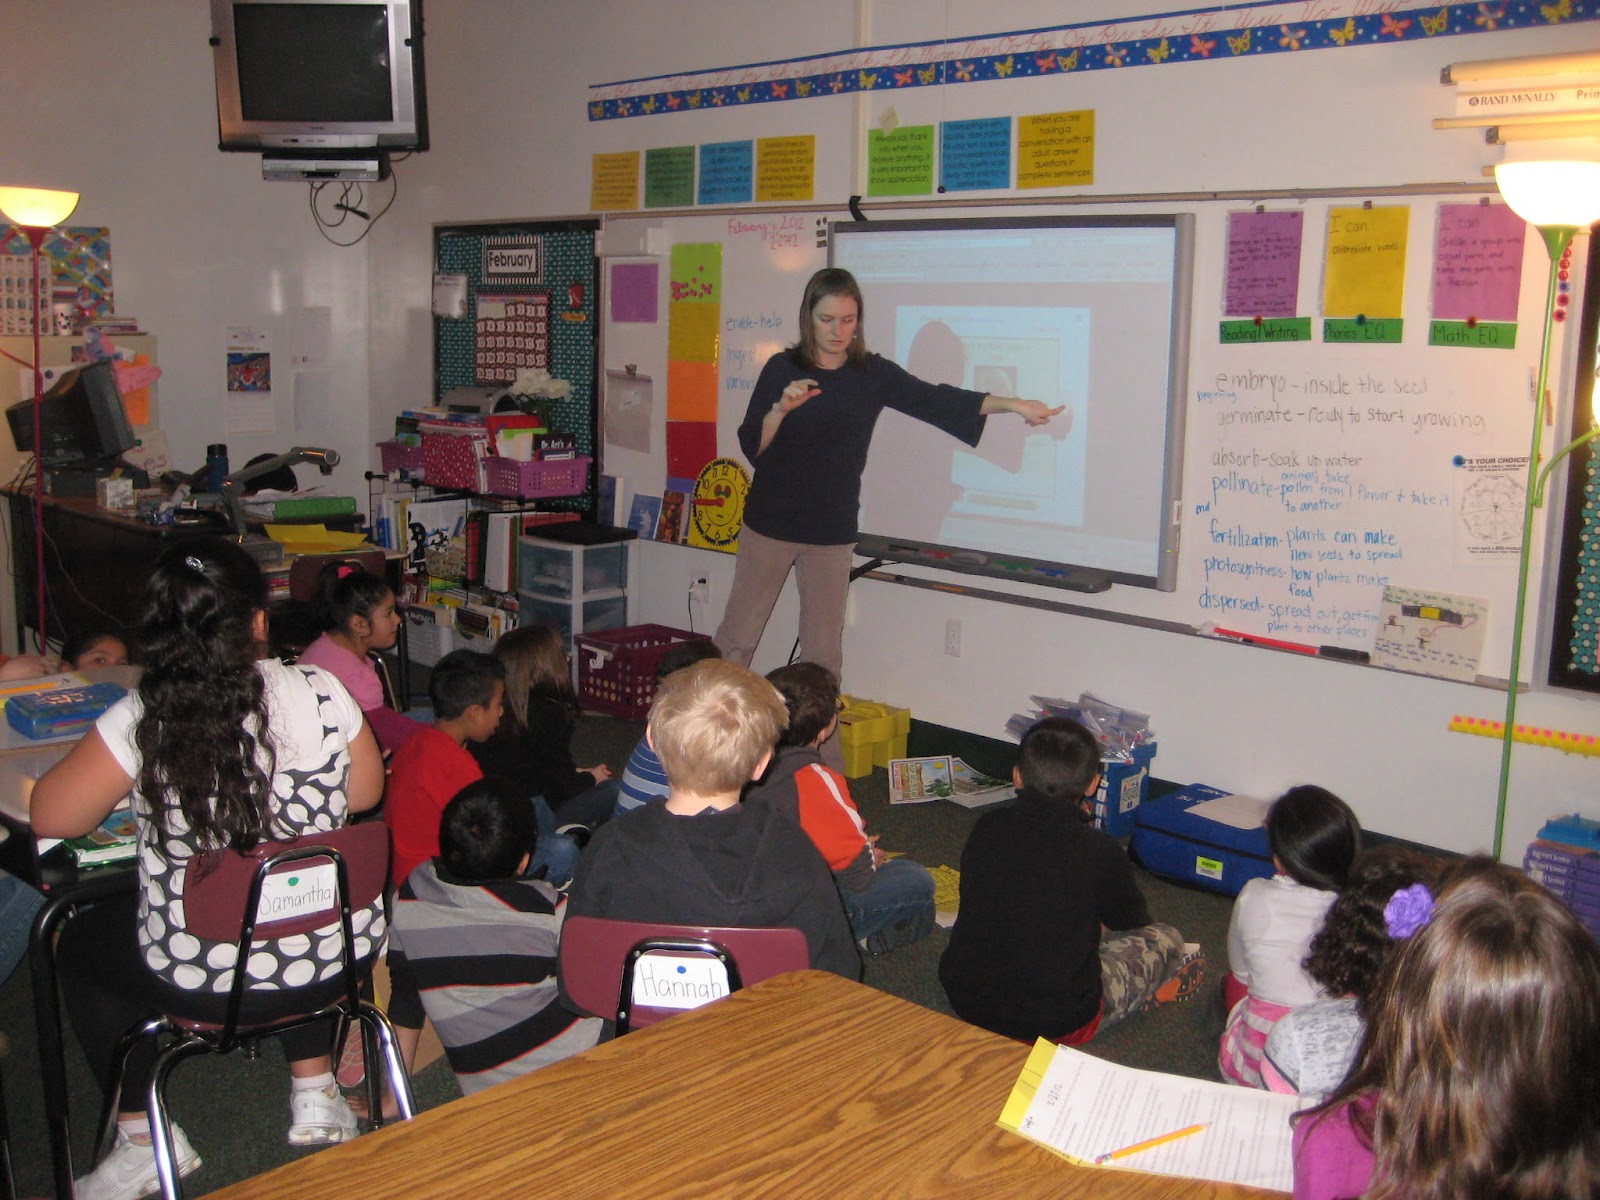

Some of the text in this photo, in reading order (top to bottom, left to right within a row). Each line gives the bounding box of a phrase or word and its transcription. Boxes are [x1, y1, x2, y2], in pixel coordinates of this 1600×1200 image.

[1480, 95, 1509, 106] RAND
[1346, 222, 1368, 233] can
[489, 252, 535, 270] February
[1432, 325, 1500, 345] Math EQ
[1215, 368, 1428, 402] embryo inside the seed
[1217, 402, 1294, 436] germinate
[1347, 406, 1361, 424] to
[1367, 408, 1404, 423] start
[1412, 410, 1488, 437] growing
[1324, 453, 1363, 468] water
[1475, 456, 1495, 465] YOUR
[721, 465, 730, 477] 12
[739, 483, 747, 496] 2
[1319, 481, 1345, 497] from
[1285, 500, 1296, 513] to
[697, 510, 704, 522] 8
[706, 523, 734, 540] 7 6 5
[1286, 524, 1327, 550] plants
[1333, 530, 1358, 545] can
[1364, 528, 1399, 547] make
[1349, 548, 1361, 561] to
[1365, 546, 1403, 566] spread
[1316, 568, 1351, 588] plants
[1355, 571, 1391, 587] make
[1287, 580, 1315, 602] food
[1267, 603, 1313, 622] spread
[1293, 622, 1304, 634] to
[260, 876, 332, 916] Samantha
[639, 962, 724, 999] Hannah
